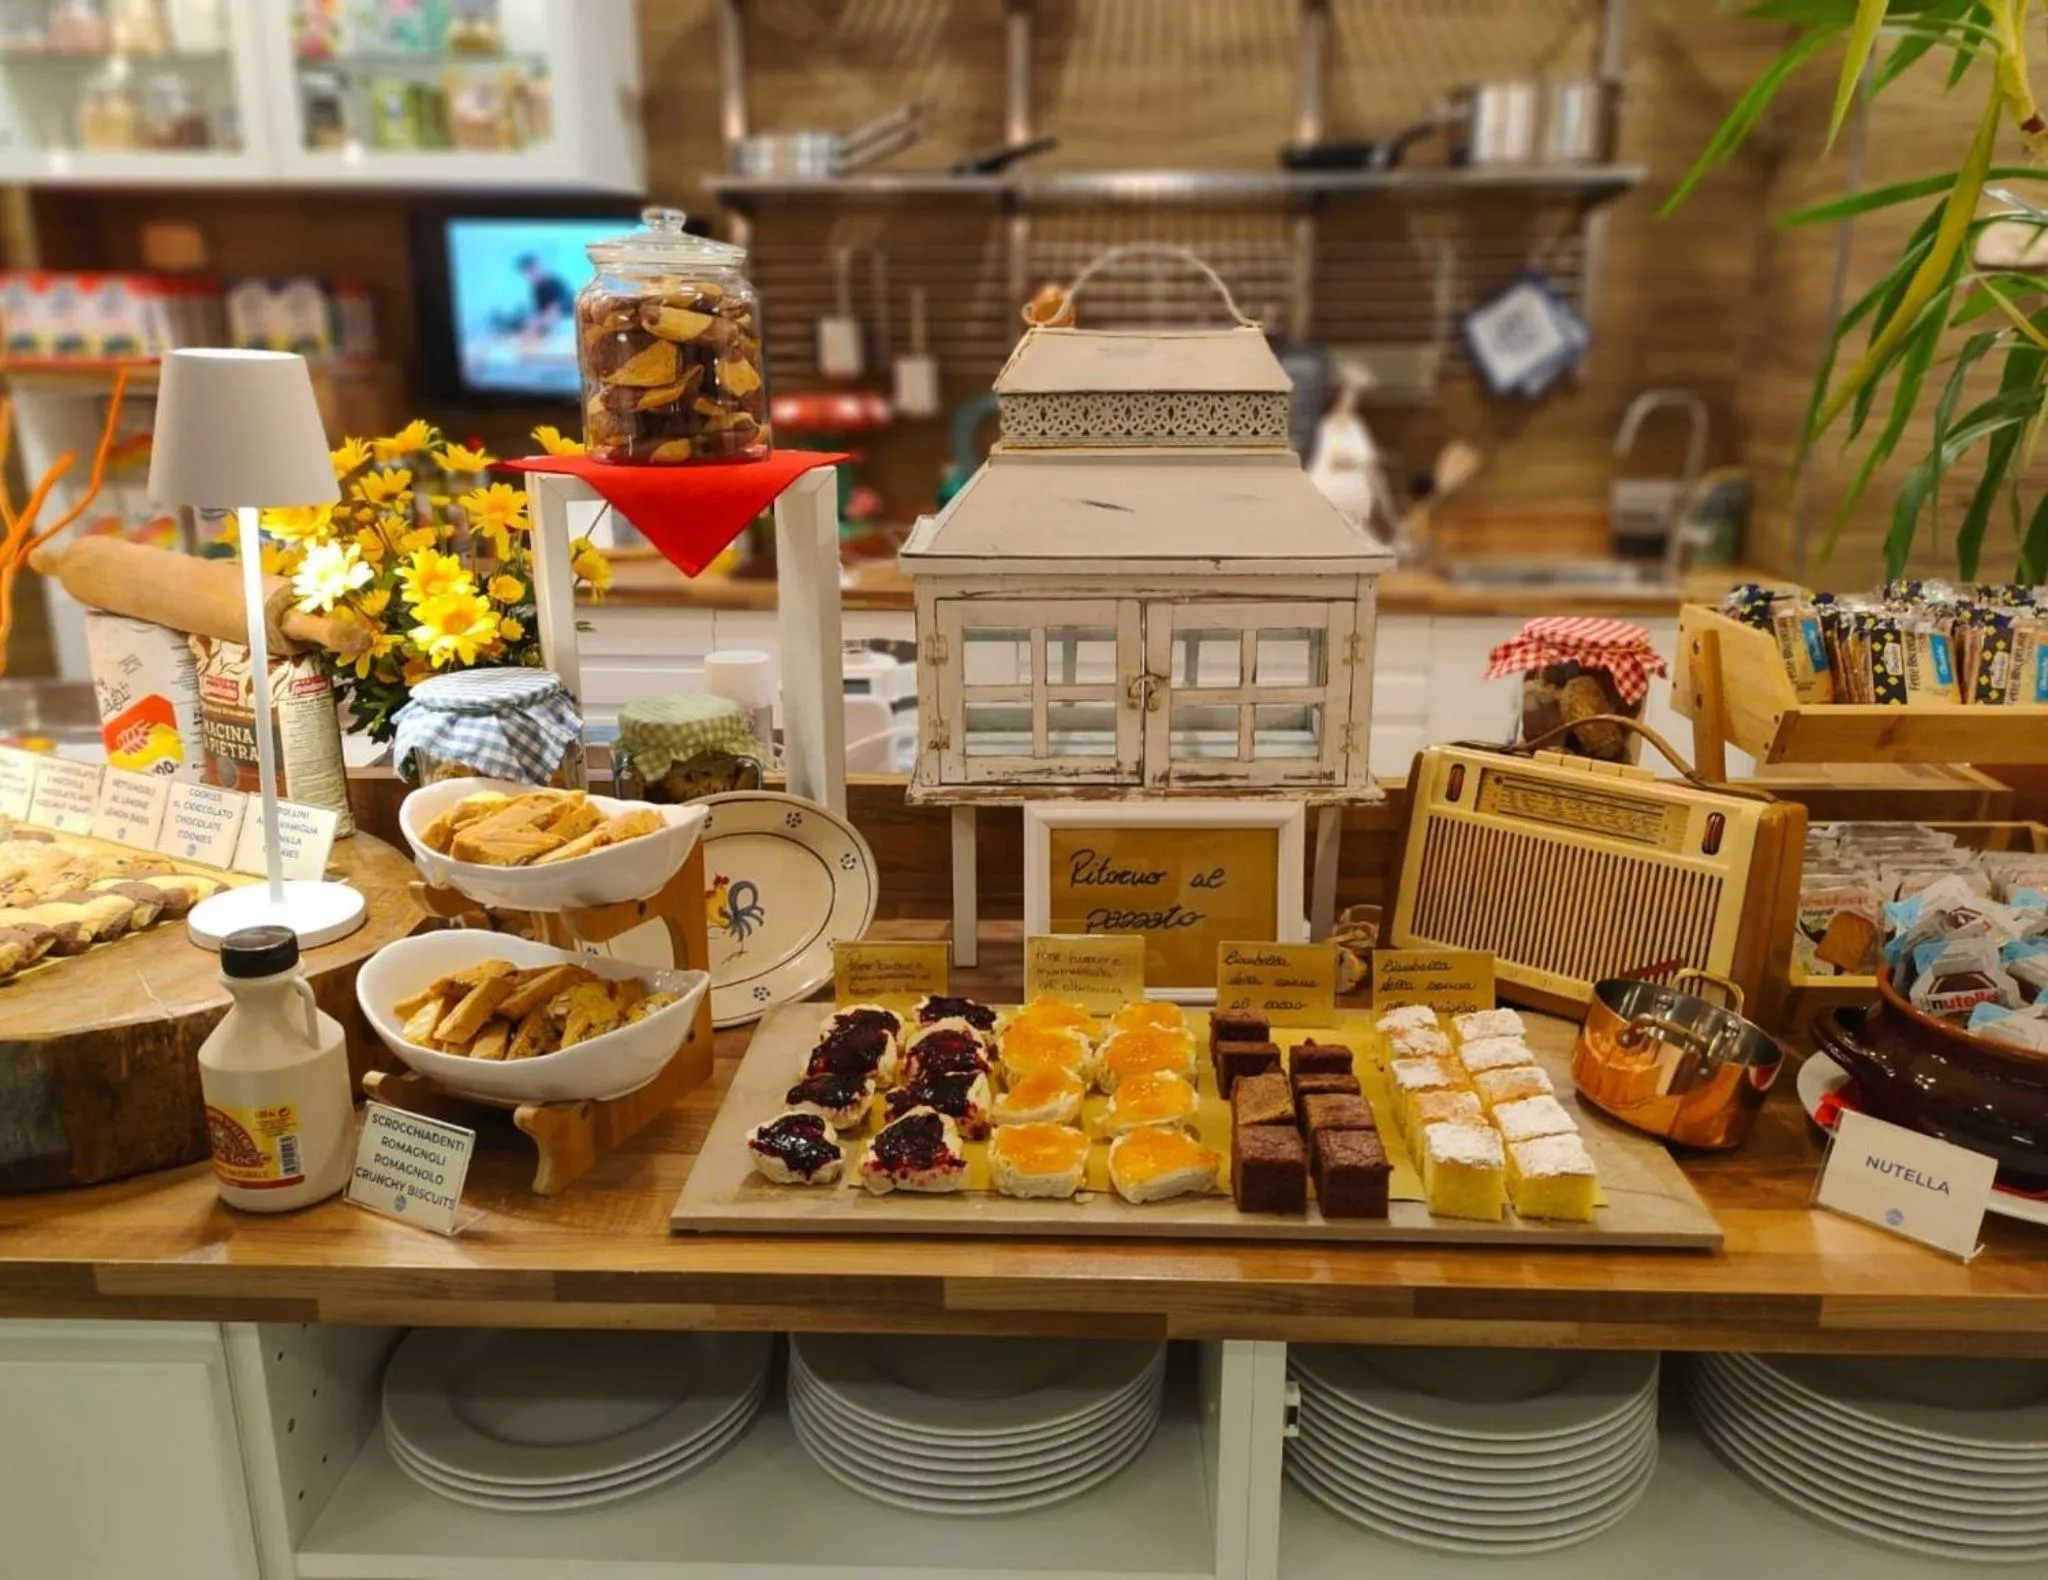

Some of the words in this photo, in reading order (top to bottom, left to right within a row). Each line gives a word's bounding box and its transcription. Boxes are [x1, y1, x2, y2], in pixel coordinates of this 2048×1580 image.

[183, 802, 233, 819] CIOCCOLATO
[188, 788, 222, 802] COOKIES
[174, 814, 222, 833] CHOCOLATE
[177, 829, 213, 845] COOKIES
[1069, 849, 1168, 889] Ritorno
[1190, 867, 1227, 889] al
[1085, 904, 1207, 935] passato
[1932, 990, 2000, 1010] nutella
[371, 1112, 465, 1153] SCROCCHIADENTI
[381, 1135, 447, 1167] ROMAGNOLI
[354, 1166, 406, 1192] CRUNCHY
[407, 1184, 456, 1210] BISCUITS
[1865, 1154, 1951, 1196] NUTELLA
